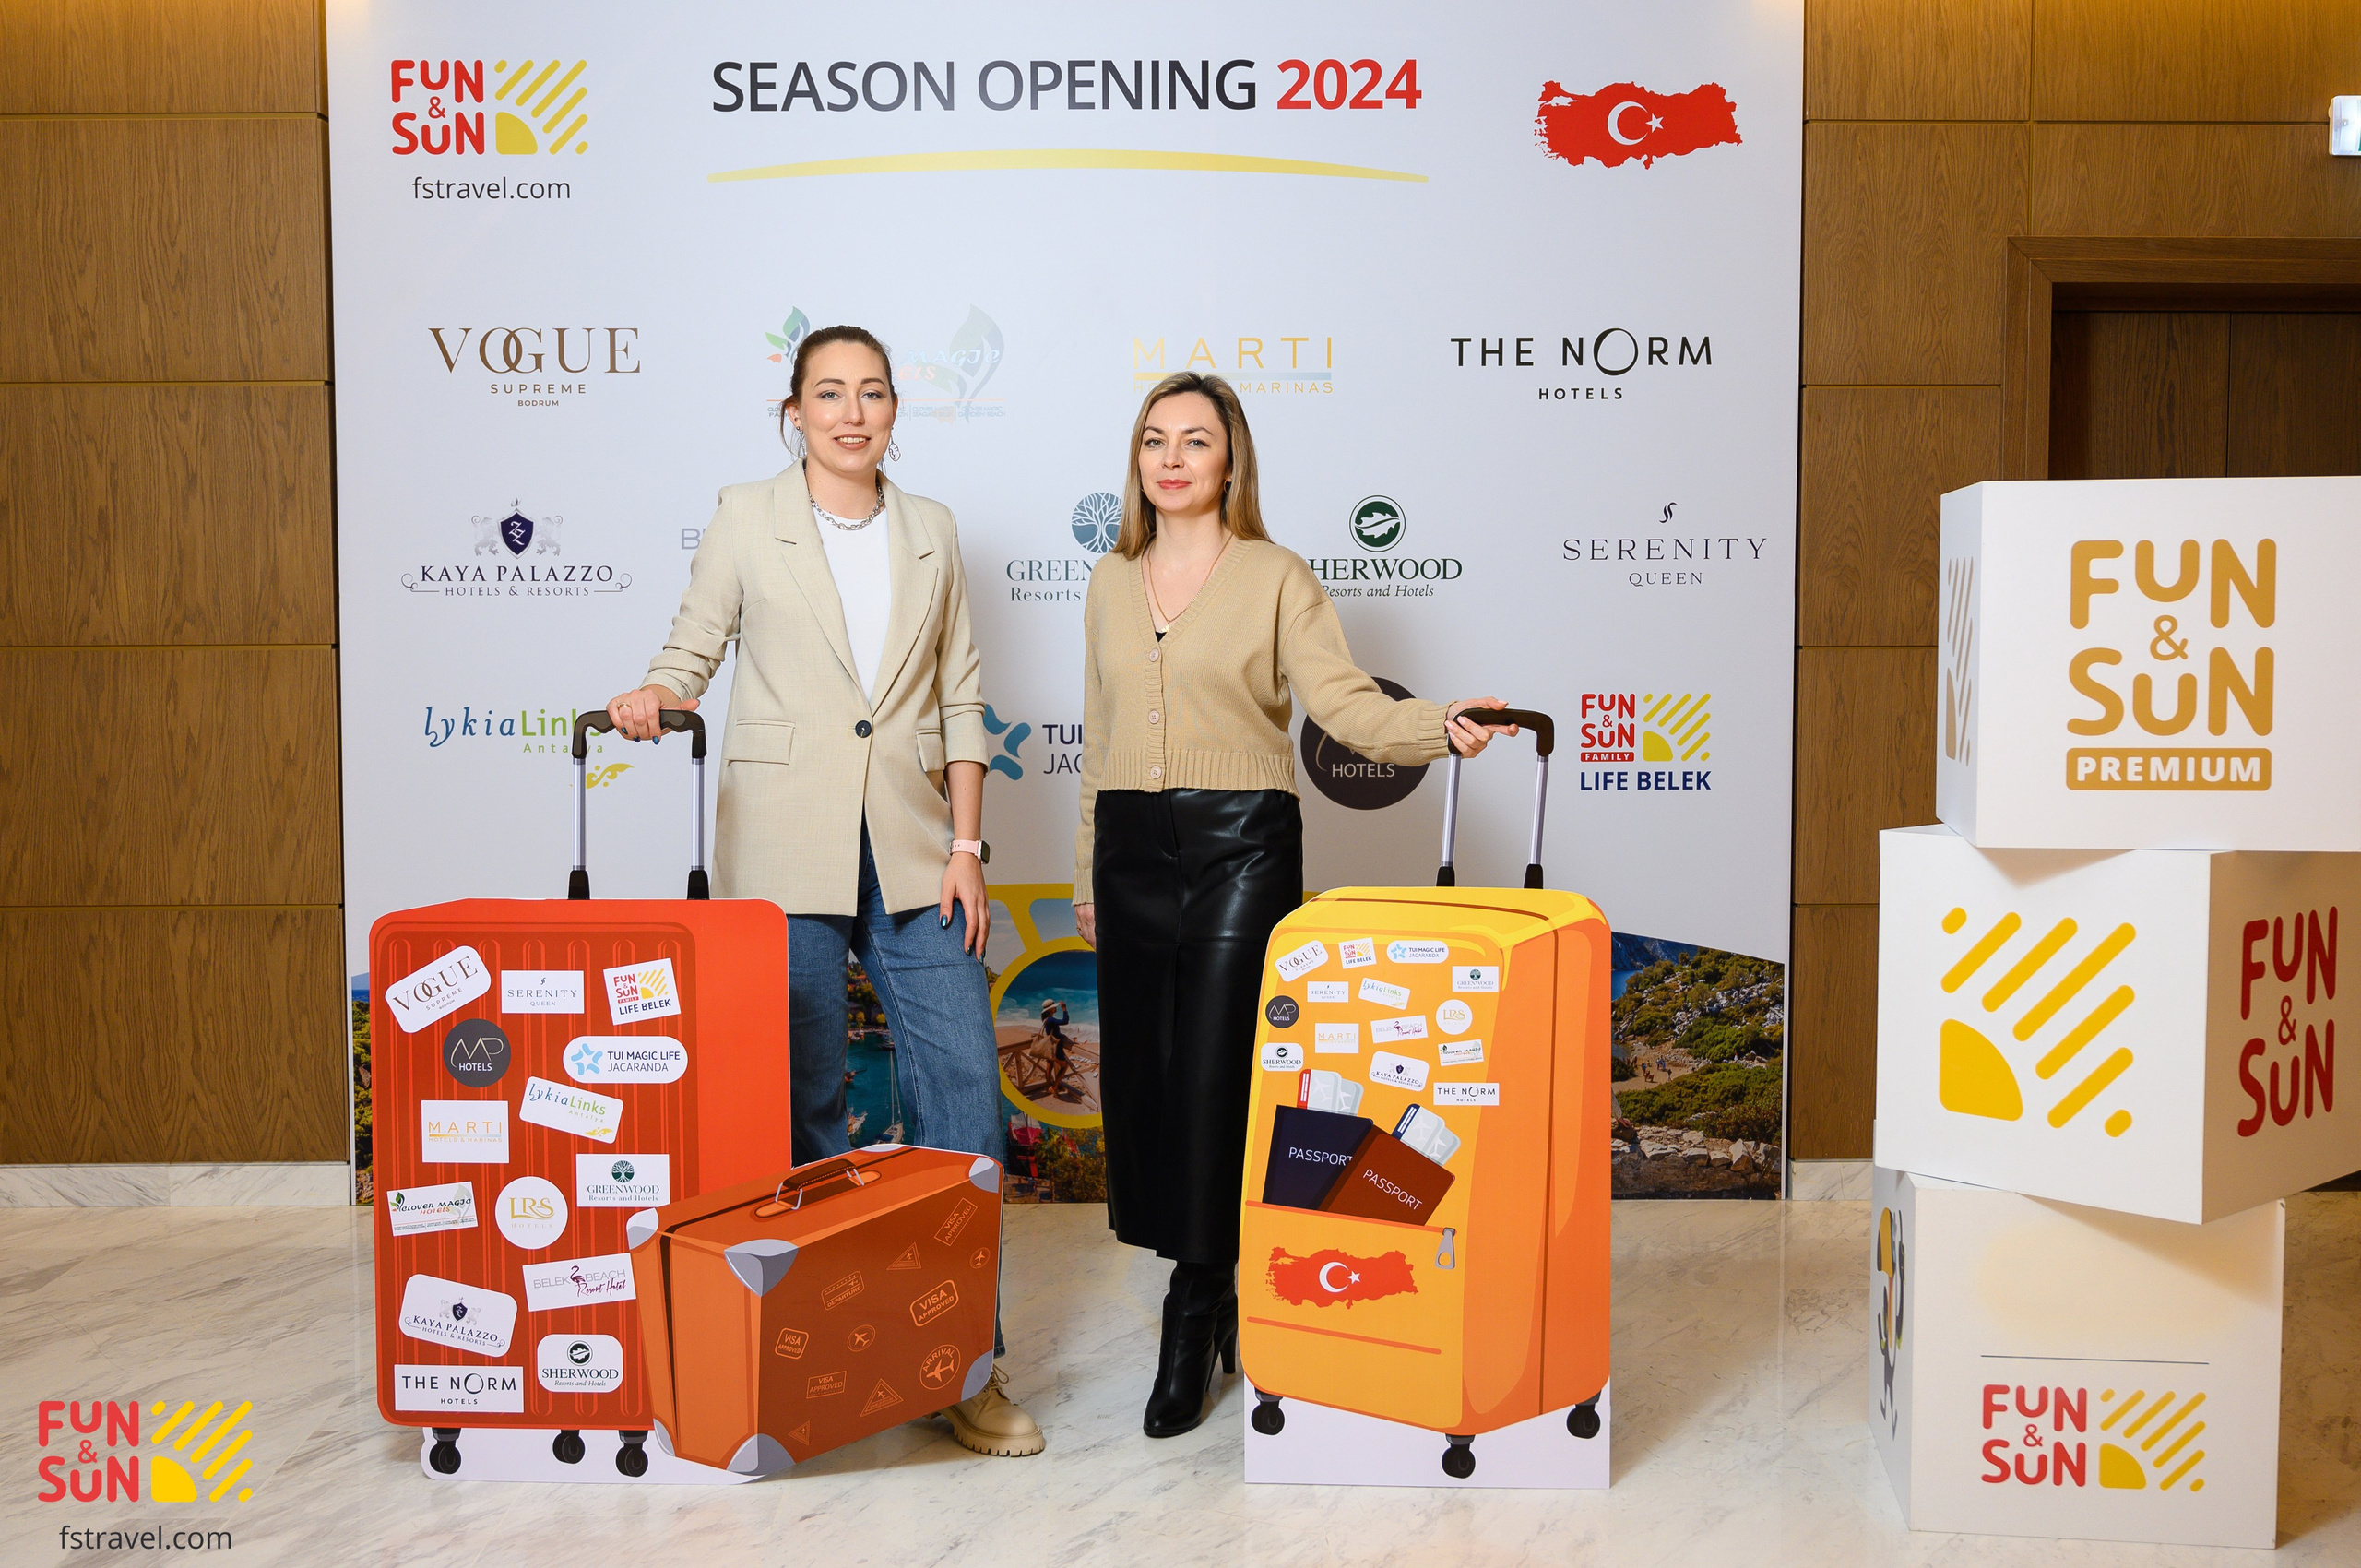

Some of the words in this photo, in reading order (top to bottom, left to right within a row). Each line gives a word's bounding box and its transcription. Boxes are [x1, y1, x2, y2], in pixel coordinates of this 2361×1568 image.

[391, 59, 484, 103] FUN
[713, 60, 955, 113] SEASON
[978, 59, 1256, 113] OPENING
[1276, 59, 1423, 111] 2024
[429, 97, 446, 119] &
[391, 111, 485, 155] SUN
[412, 176, 571, 200] fstravel.com
[428, 327, 641, 374] VOGUE
[1133, 337, 1332, 369] MARTI
[1452, 337, 1535, 367] THE
[1562, 327, 1713, 376] NORM
[490, 383, 587, 395] SUPREME
[1240, 382, 1334, 394] MARINAS
[1538, 387, 1623, 400] HOTELS
[517, 398, 560, 407] BODRUM
[1563, 537, 1768, 561] SERENITY
[421, 565, 487, 582] KAYA
[496, 565, 613, 582] PALAZZO
[1006, 559, 1098, 581] GREEN
[1307, 558, 1463, 580] HERWOOD
[1628, 572, 1703, 587] QUEEN
[445, 586, 501, 597] HOTELS
[508, 585, 519, 597] &
[527, 586, 590, 597] RESORTS
[1010, 587, 1081, 601] Resorts
[1367, 584, 1391, 597] and
[1394, 584, 1435, 597] Hotels
[2070, 538, 2277, 630] FUN
[2150, 614, 2189, 661] &
[2067, 646, 2274, 737] SUN
[1581, 693, 1635, 719] FUN
[1602, 714, 1613, 728] &
[1042, 724, 1083, 745] TUI
[1580, 723, 1635, 748] SUN
[1584, 753, 1631, 761] FAMILY
[1332, 763, 1395, 778] HOTELS
[1580, 771, 1628, 790] LIFE
[1637, 771, 1712, 790] BELEK
[2076, 756, 2260, 783] PREMIUM
[2241, 906, 2338, 1021] FUN
[393, 956, 478, 1011] VOGUE
[613, 973, 636, 987] FUN
[426, 987, 463, 1011] SUPREME
[507, 990, 578, 998] SERENITY
[615, 985, 638, 998] SUN
[619, 1004, 639, 1015] LIFE
[641, 998, 671, 1011] BELEK
[2278, 995, 2296, 1046] &
[458, 1063, 492, 1071] HOTELS
[607, 1051, 623, 1060] TUI
[627, 1051, 658, 1061] MAGIC
[660, 1051, 681, 1060] LIFE
[608, 1063, 669, 1072] JACARANDA
[2236, 1018, 2335, 1137] SUN
[1461, 1086, 1496, 1098] NORM
[568, 1109, 604, 1123] Antalya
[428, 1121, 503, 1134] MARTI
[587, 1184, 660, 1194] GREENWOOD
[1362, 1169, 1423, 1210] PASSPORT
[509, 1197, 555, 1219] LRS
[533, 1276, 571, 1289] BELEK
[585, 1268, 626, 1282] BEACH
[919, 1289, 947, 1310] VISA
[919, 1295, 955, 1322] APPROVED
[413, 1315, 442, 1329] KAYA
[445, 1323, 498, 1342] PALAZZO
[421, 1326, 447, 1336] HOTELS
[785, 1334, 801, 1346] VISA
[922, 1348, 955, 1372] ARRIVAL
[402, 1375, 439, 1390] THE
[450, 1372, 516, 1395] NORM
[541, 1368, 619, 1379] SHERWOOD
[1982, 1384, 2088, 1433] FUN
[2023, 1423, 2044, 1447] &
[1981, 1438, 2087, 1487] SUN
